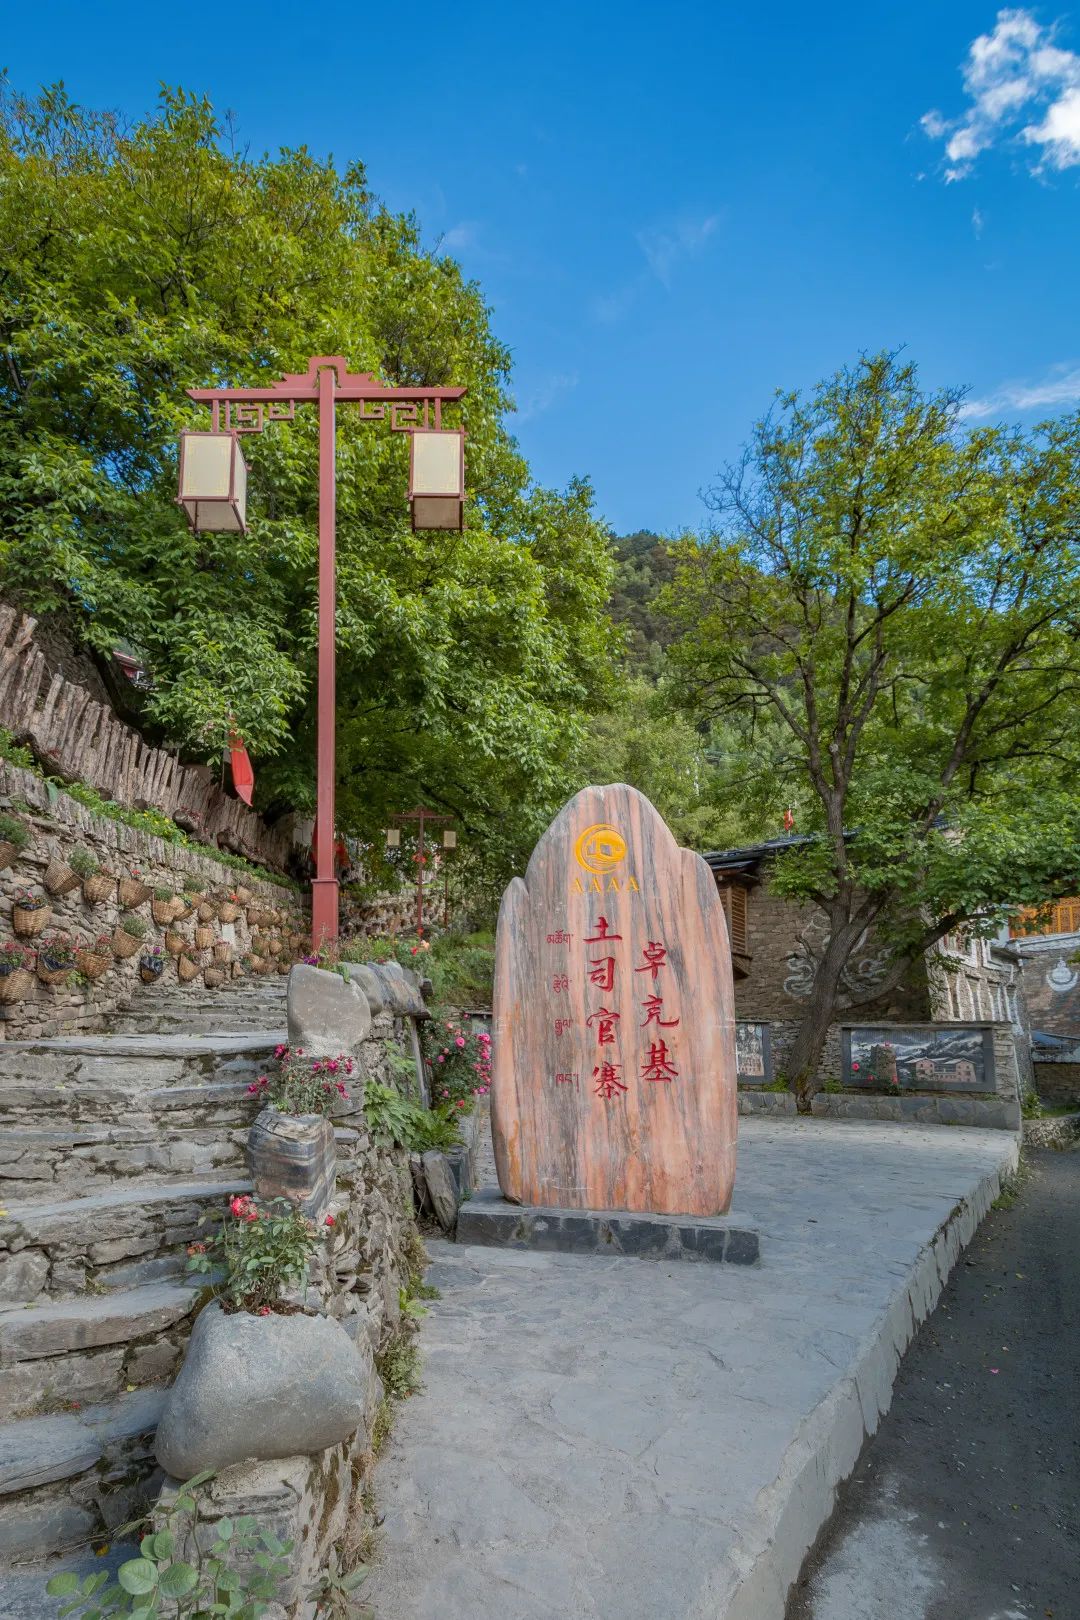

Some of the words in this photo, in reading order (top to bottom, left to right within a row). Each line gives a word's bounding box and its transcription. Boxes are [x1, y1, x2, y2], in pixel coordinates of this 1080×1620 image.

[571, 876, 639, 893] AAAA
[583, 916, 628, 1101] 土司官寨
[634, 941, 680, 1082] 卓克基
